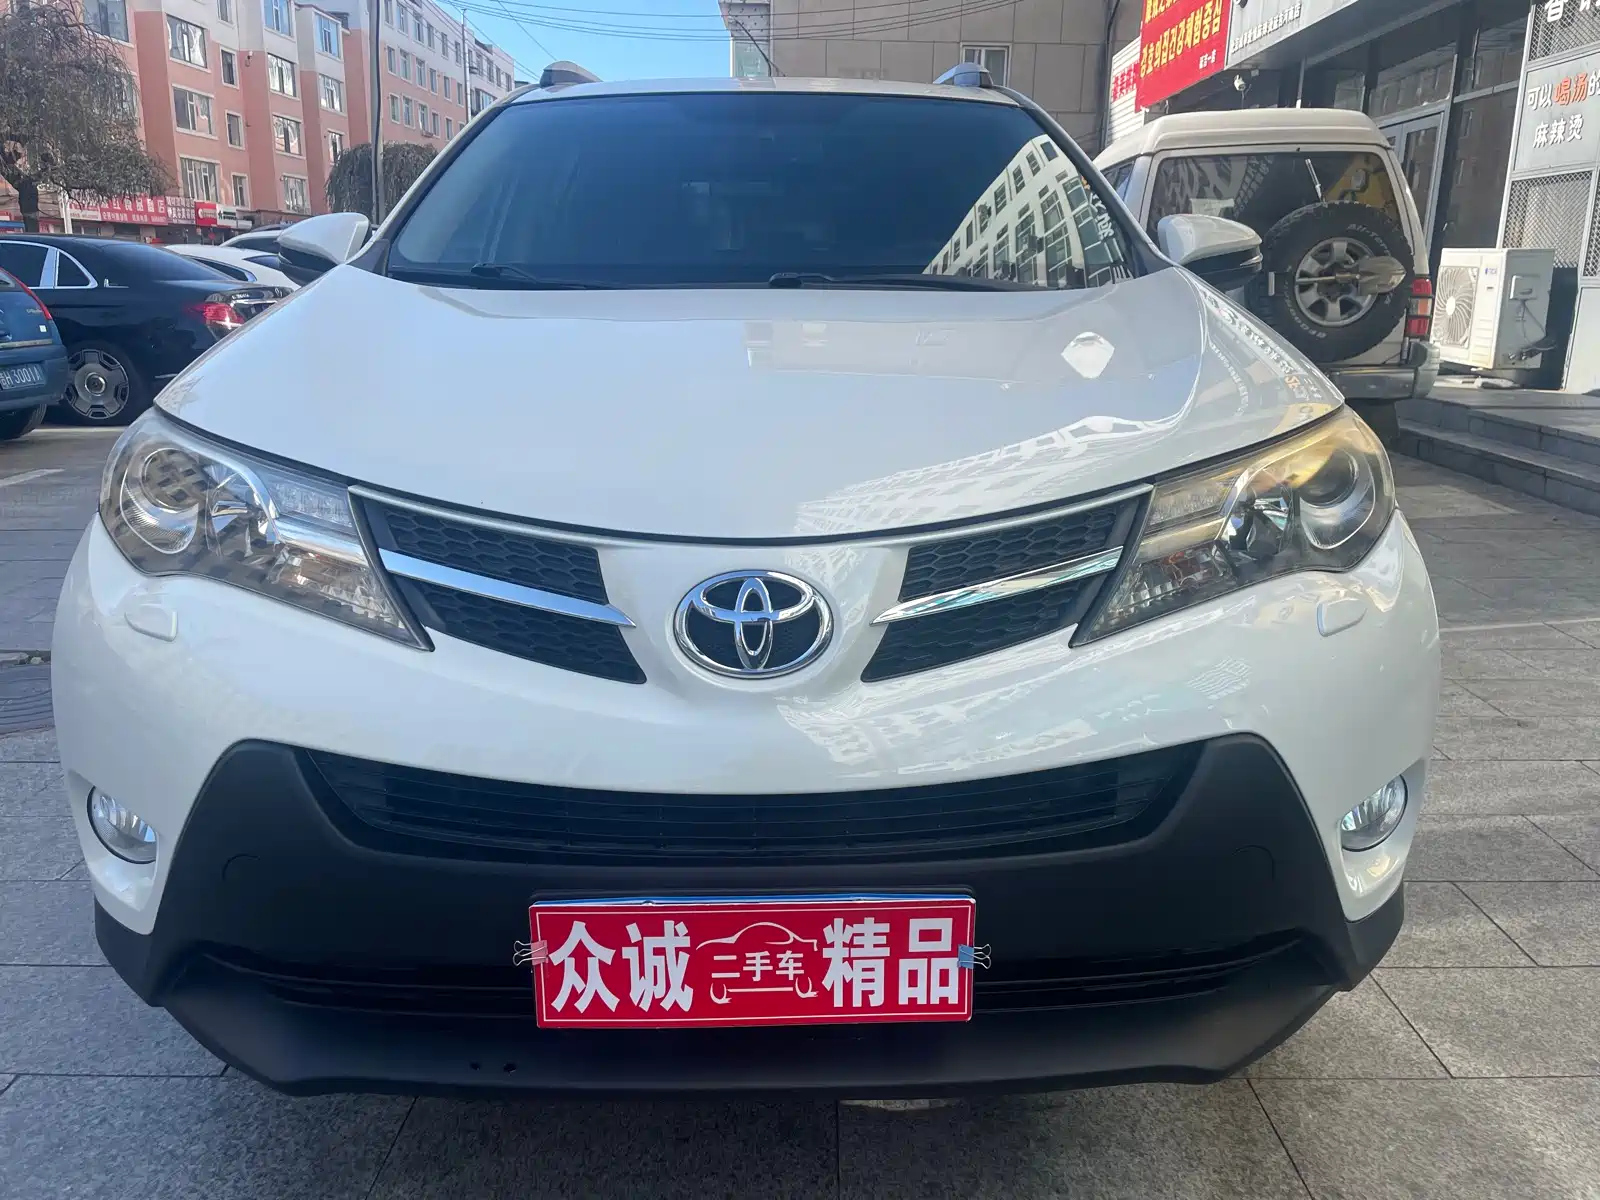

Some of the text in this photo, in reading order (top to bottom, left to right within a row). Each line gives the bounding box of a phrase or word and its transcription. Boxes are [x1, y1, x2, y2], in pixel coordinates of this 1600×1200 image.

[1533, 114, 1583, 148] 麻辣烫
[548, 917, 958, 1014] 众诚 二手车 精品
